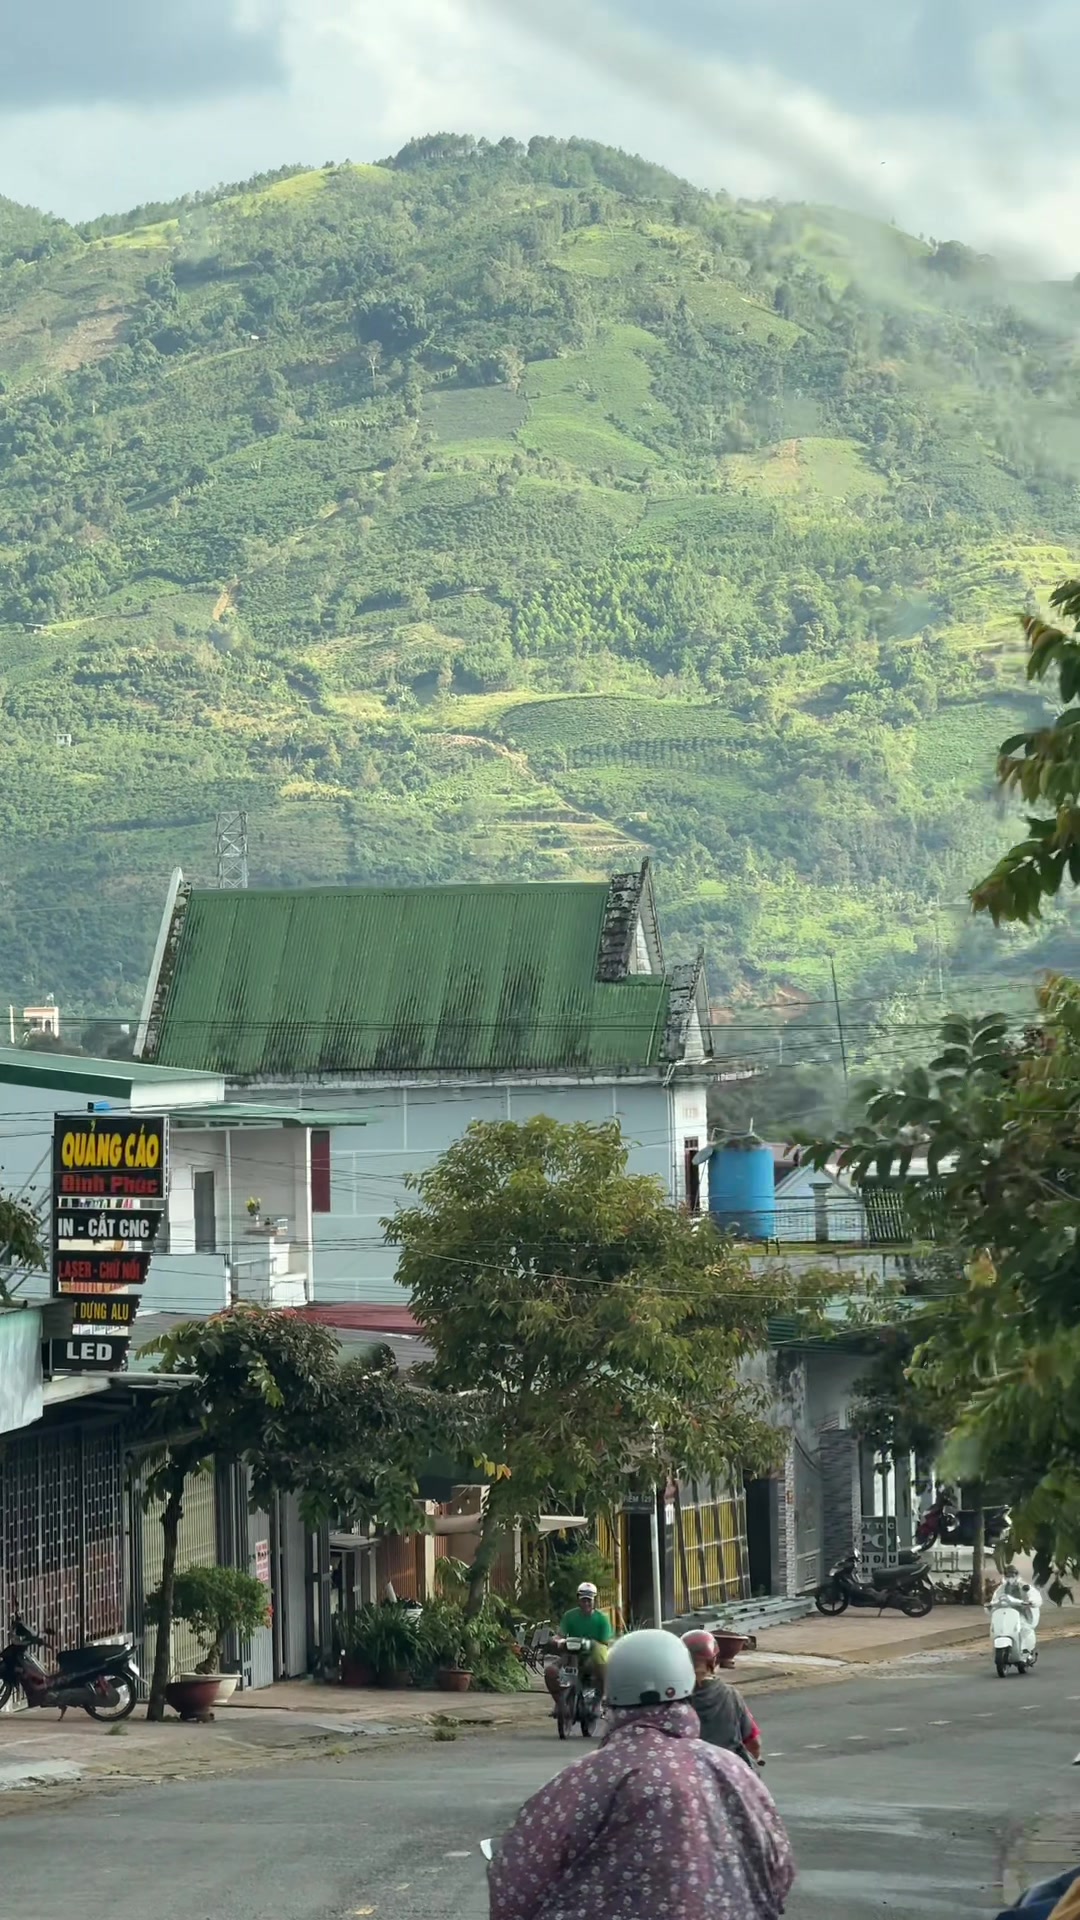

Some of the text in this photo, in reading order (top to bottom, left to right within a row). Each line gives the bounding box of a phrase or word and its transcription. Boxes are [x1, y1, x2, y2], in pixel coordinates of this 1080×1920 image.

[62, 1119, 159, 1169] QUẢNG CÁO
[57, 1217, 74, 1237] IN
[88, 1211, 116, 1238] CẮT
[119, 1218, 150, 1238] CNC
[58, 1260, 92, 1278] LASER
[80, 1300, 107, 1323] DỰNG
[111, 1303, 129, 1321] ALU
[66, 1341, 113, 1361] LED
